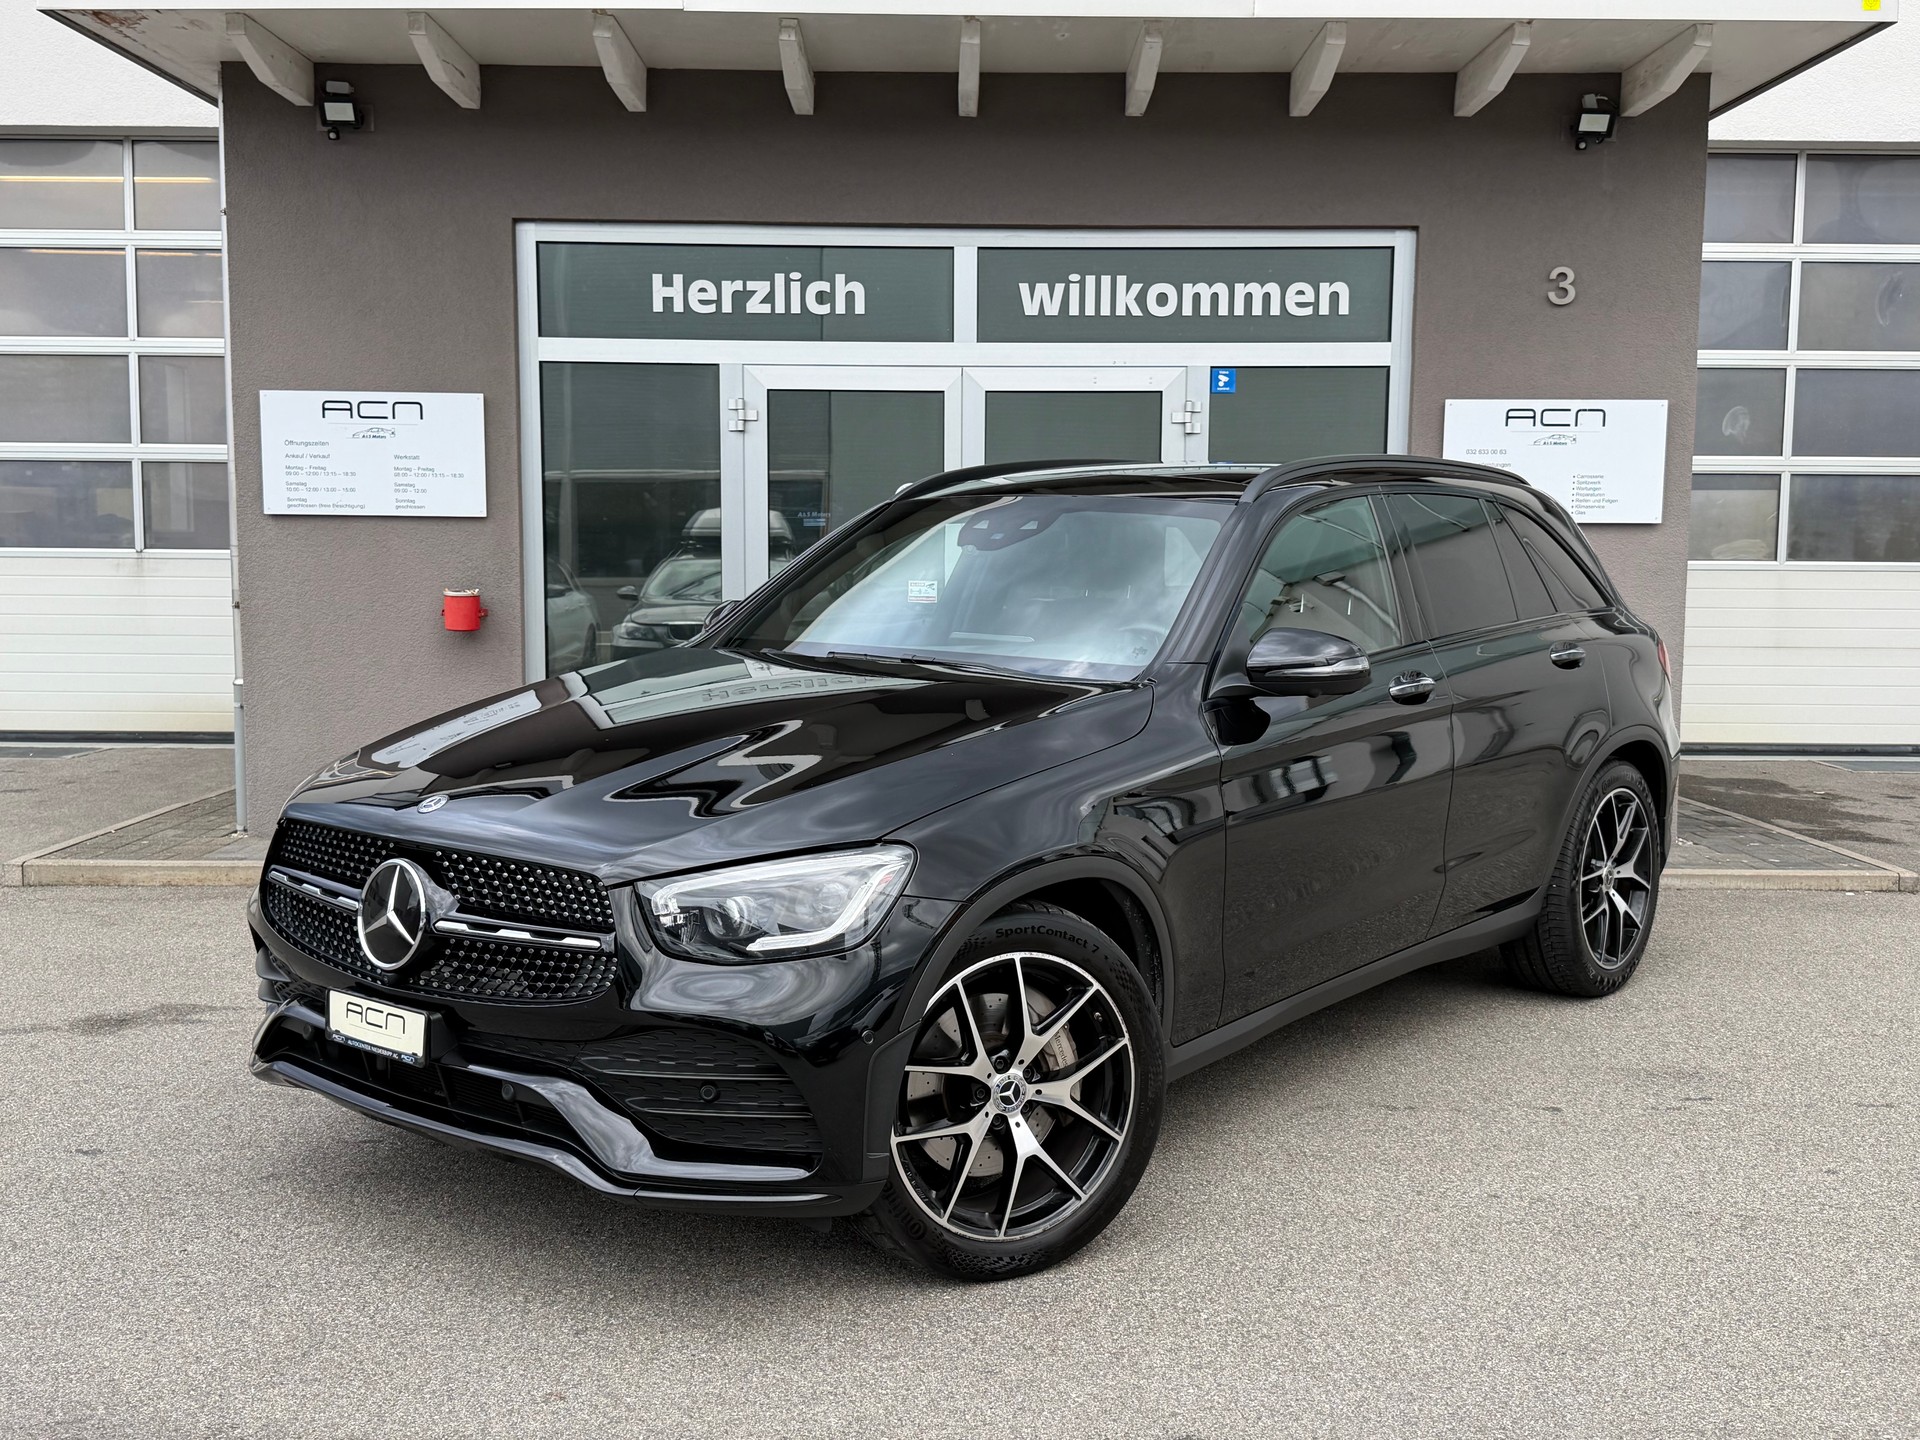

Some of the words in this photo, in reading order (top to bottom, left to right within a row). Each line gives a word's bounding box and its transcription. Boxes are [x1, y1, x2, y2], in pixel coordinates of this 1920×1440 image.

[652, 272, 865, 315] Herzlich
[1018, 273, 1350, 317] willkommen
[1547, 266, 1576, 305] 3
[996, 925, 1088, 949] SportContact
[1091, 944, 1100, 953] 7
